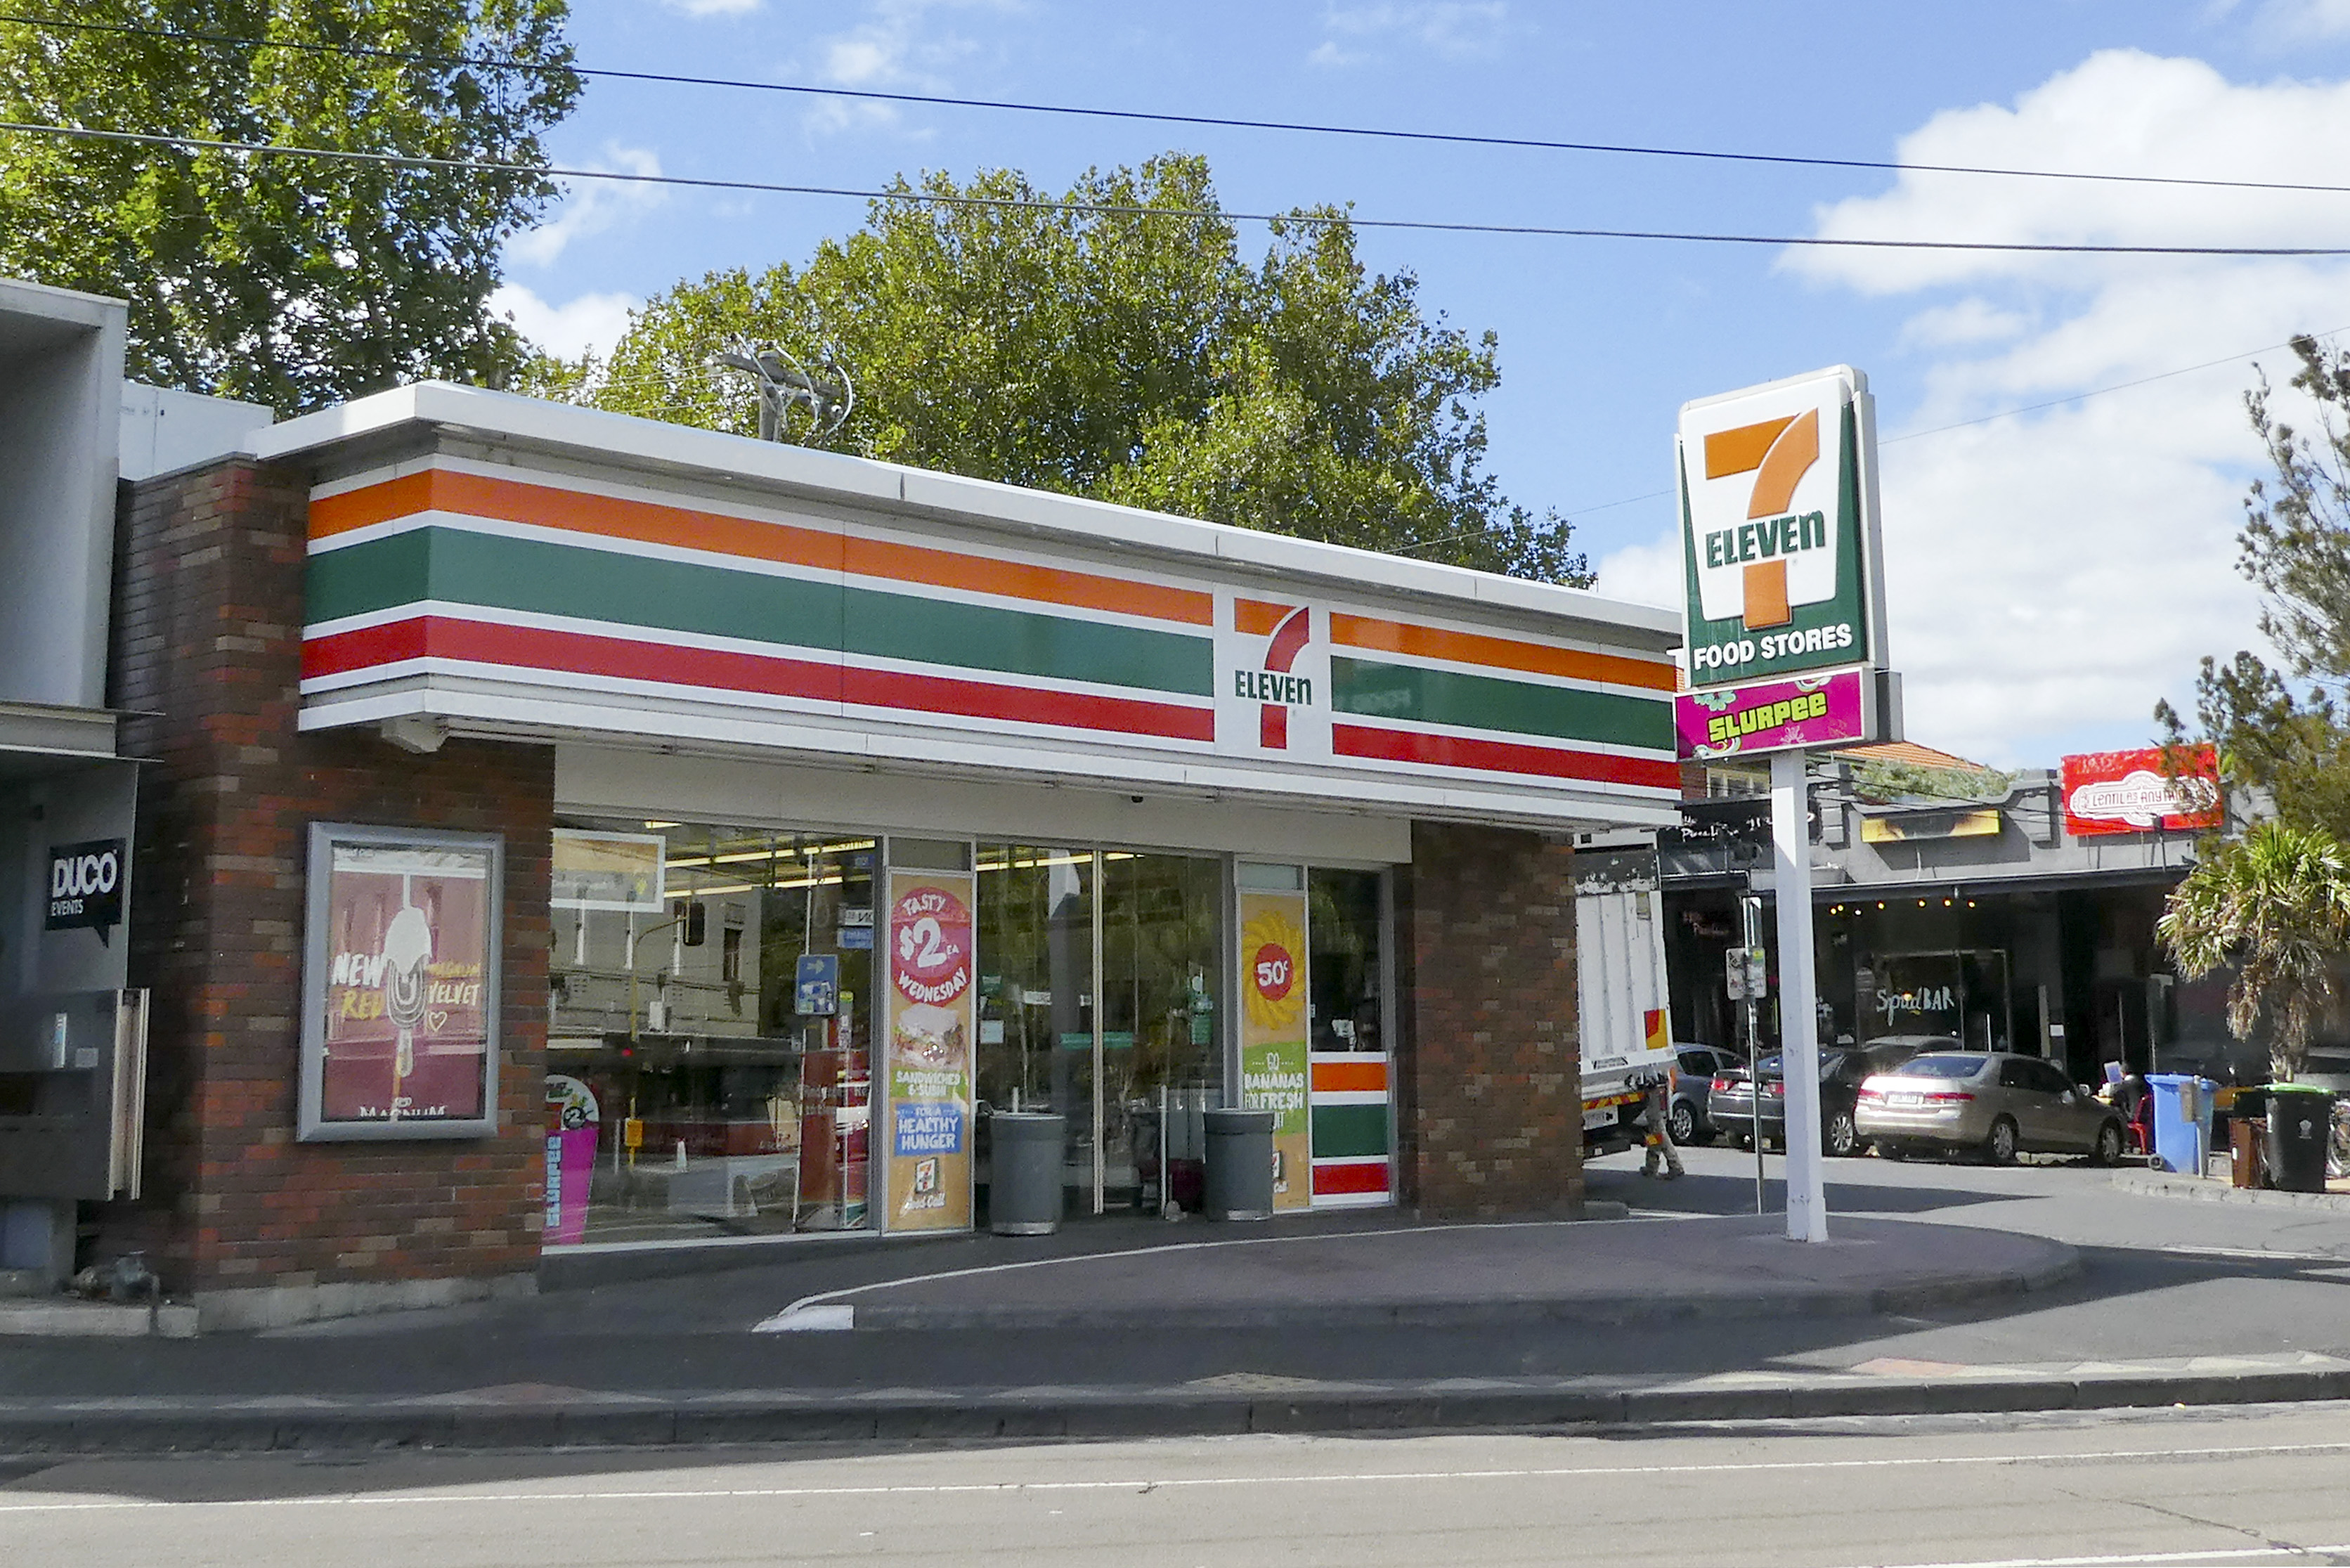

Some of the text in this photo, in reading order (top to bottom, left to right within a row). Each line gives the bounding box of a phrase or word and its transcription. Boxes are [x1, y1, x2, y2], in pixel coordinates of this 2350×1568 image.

[1703, 408, 1820, 630] 7
[1694, 623, 1853, 671] FOOD STORES
[1234, 597, 1310, 750] 7
[53, 851, 118, 898] DUCO
[51, 899, 84, 916] EVENTS
[902, 893, 947, 916] TASTY
[899, 916, 947, 968] $2
[332, 951, 386, 988] NEW
[427, 980, 481, 1006] VELVET
[898, 966, 968, 1004] WEDNESDAY
[340, 990, 382, 1023] RED
[896, 1070, 961, 1086] SANDWICHES
[918, 1084, 947, 1096] SUSHI
[1244, 1072, 1304, 1089] BANANAS
[935, 1106, 942, 1117] A
[1245, 1091, 1304, 1111] FOR FRESH
[898, 1116, 959, 1134] HEALTHY
[901, 1132, 956, 1151] HUNGER
